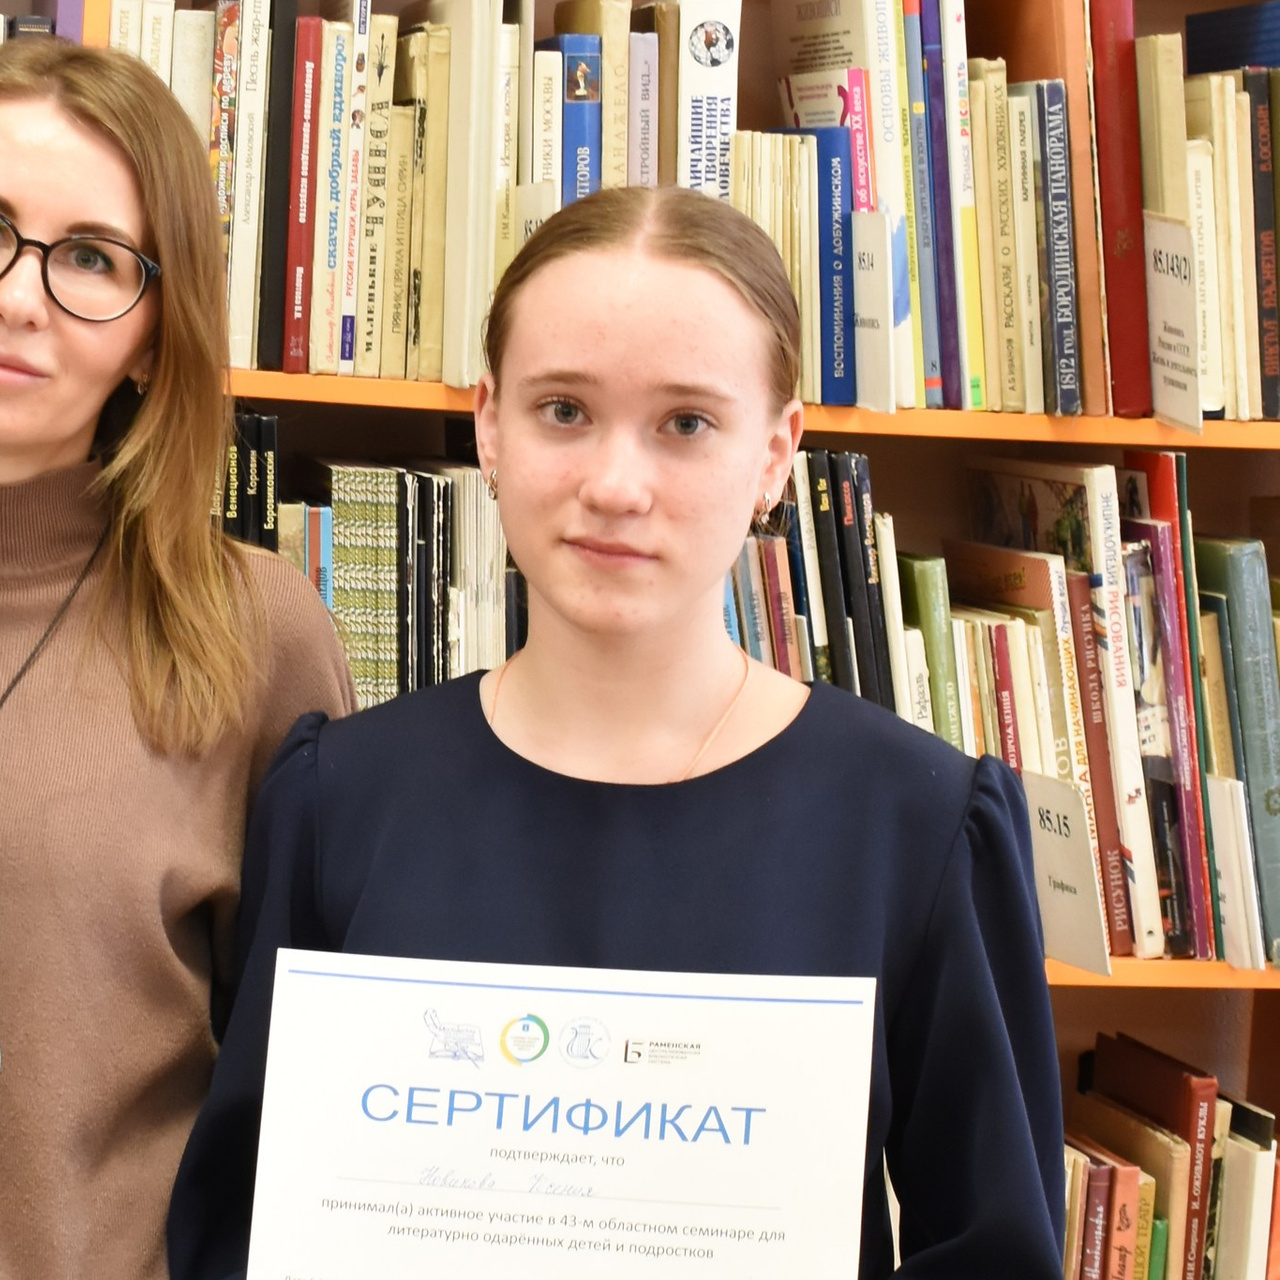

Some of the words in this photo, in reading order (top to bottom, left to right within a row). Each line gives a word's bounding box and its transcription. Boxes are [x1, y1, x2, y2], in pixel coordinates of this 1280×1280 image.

[1047, 103, 1067, 194] ПАНОРАМА
[830, 157, 844, 255] ДОБУЖИНСКОМ
[833, 260, 843, 270] О
[1052, 200, 1073, 323] БОРОДИНСКАЯ
[1152, 247, 1191, 285] 85.143(2)
[833, 275, 844, 378] ВОСПОМИНАНИЯ
[1059, 358, 1076, 390] 1812
[226, 446, 238, 518] Венецианов
[247, 450, 258, 495] Коровин
[264, 451, 275, 529] Боровиковский
[1038, 806, 1071, 839] 85.15
[649, 1041, 701, 1050] РАМЕНСКАЯ
[361, 1084, 766, 1145] СЕРТИФИКАТ
[490, 1147, 597, 1166] подтверждает,
[601, 1156, 625, 1166] что
[322, 1198, 413, 1217] принимал(а)
[418, 1206, 483, 1220] активное
[488, 1212, 543, 1225] участие
[548, 1217, 554, 1225] в
[560, 1215, 594, 1230] 43-м
[598, 1219, 678, 1234] областном
[682, 1226, 754, 1241] семинаре
[758, 1230, 786, 1242] для
[388, 1224, 478, 1241] литературно
[483, 1232, 563, 1248] одарённых
[568, 1238, 611, 1252] детей
[616, 1243, 624, 1251] и
[629, 1242, 714, 1260] подростков
